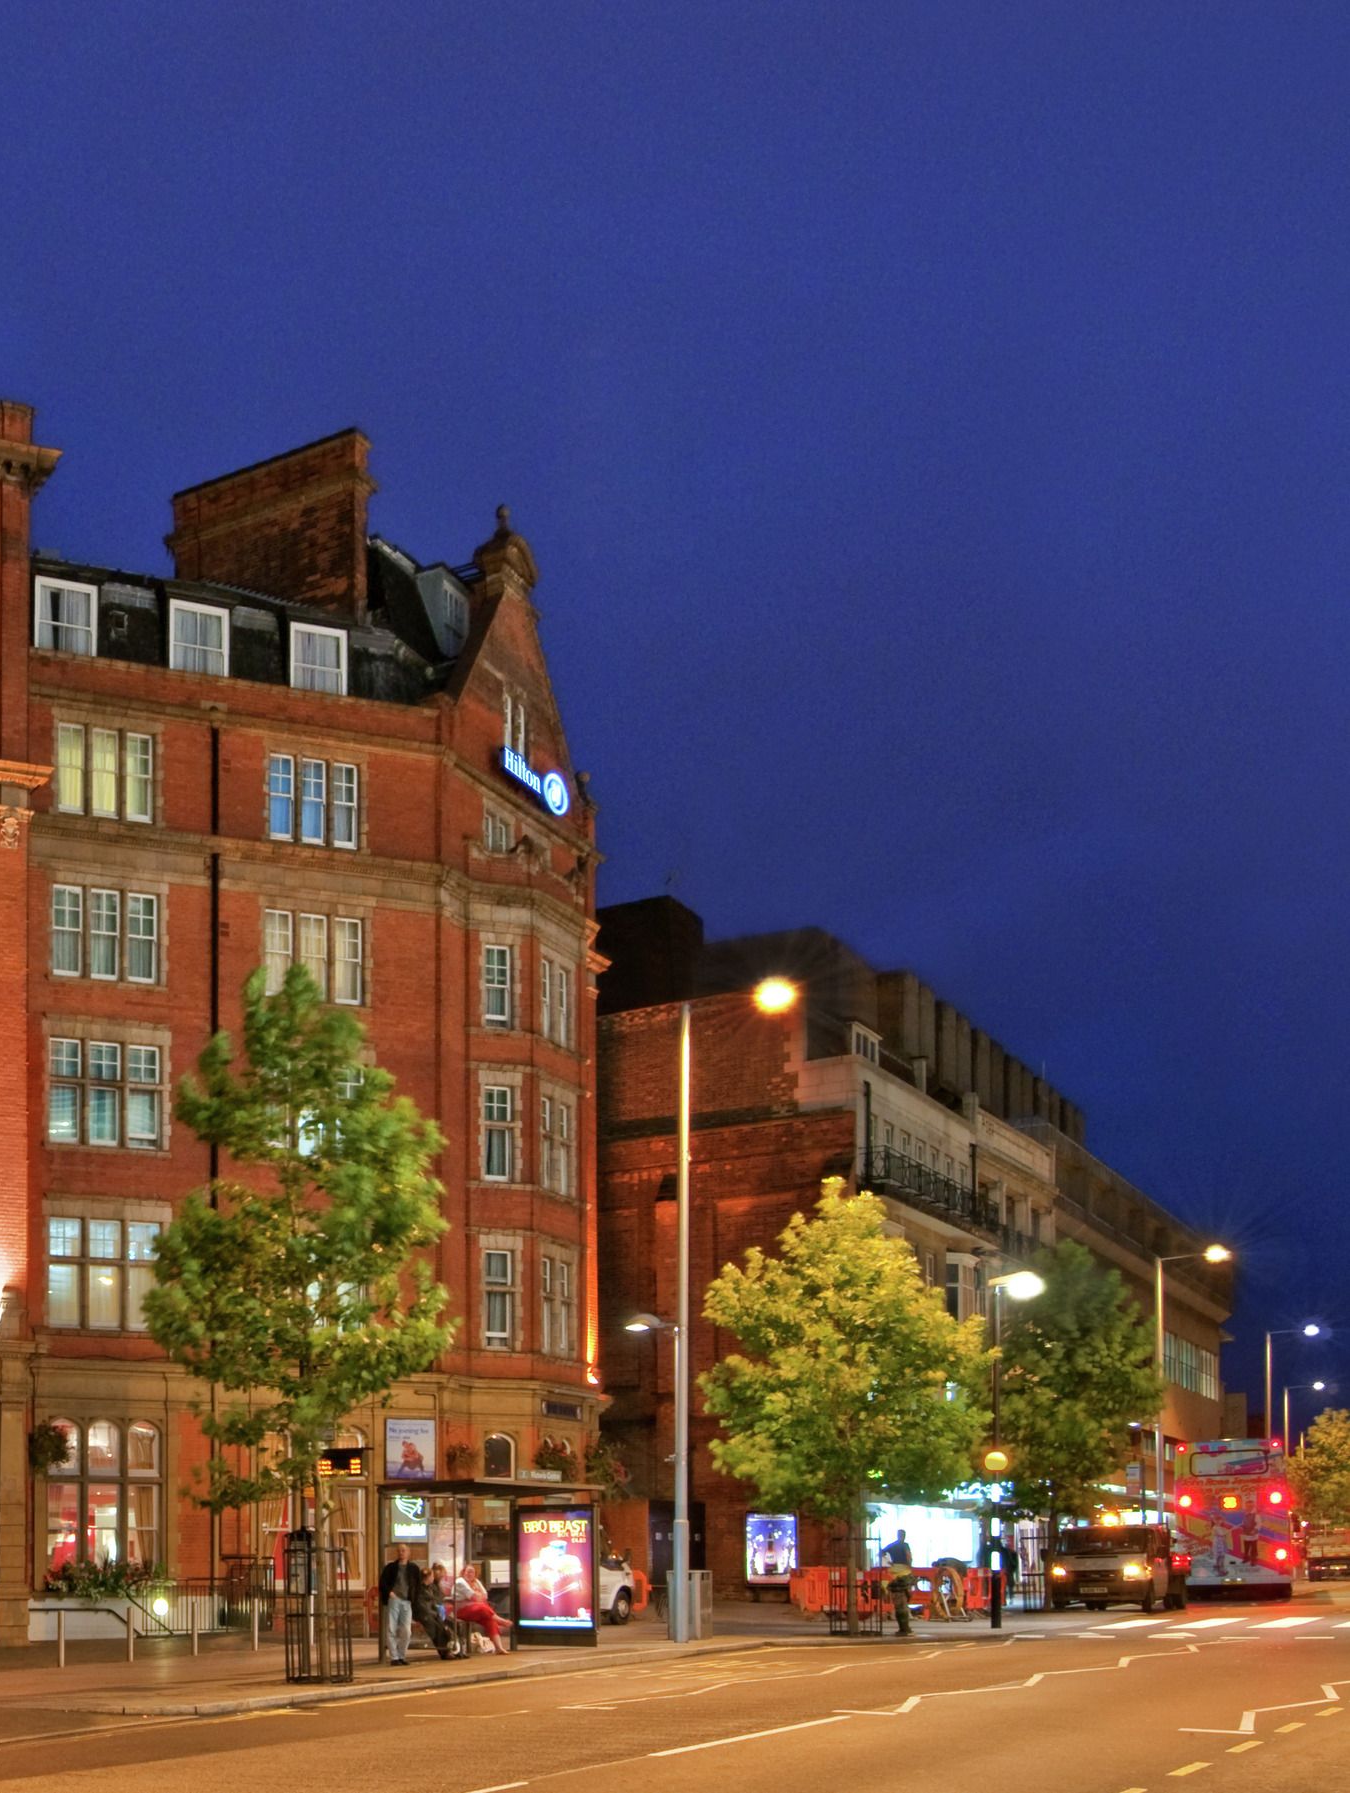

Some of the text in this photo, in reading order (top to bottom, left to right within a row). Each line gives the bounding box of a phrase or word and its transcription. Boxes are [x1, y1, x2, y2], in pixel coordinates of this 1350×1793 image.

[504, 747, 541, 794] Hilton
[522, 1519, 588, 1534] BBQ BEAST
